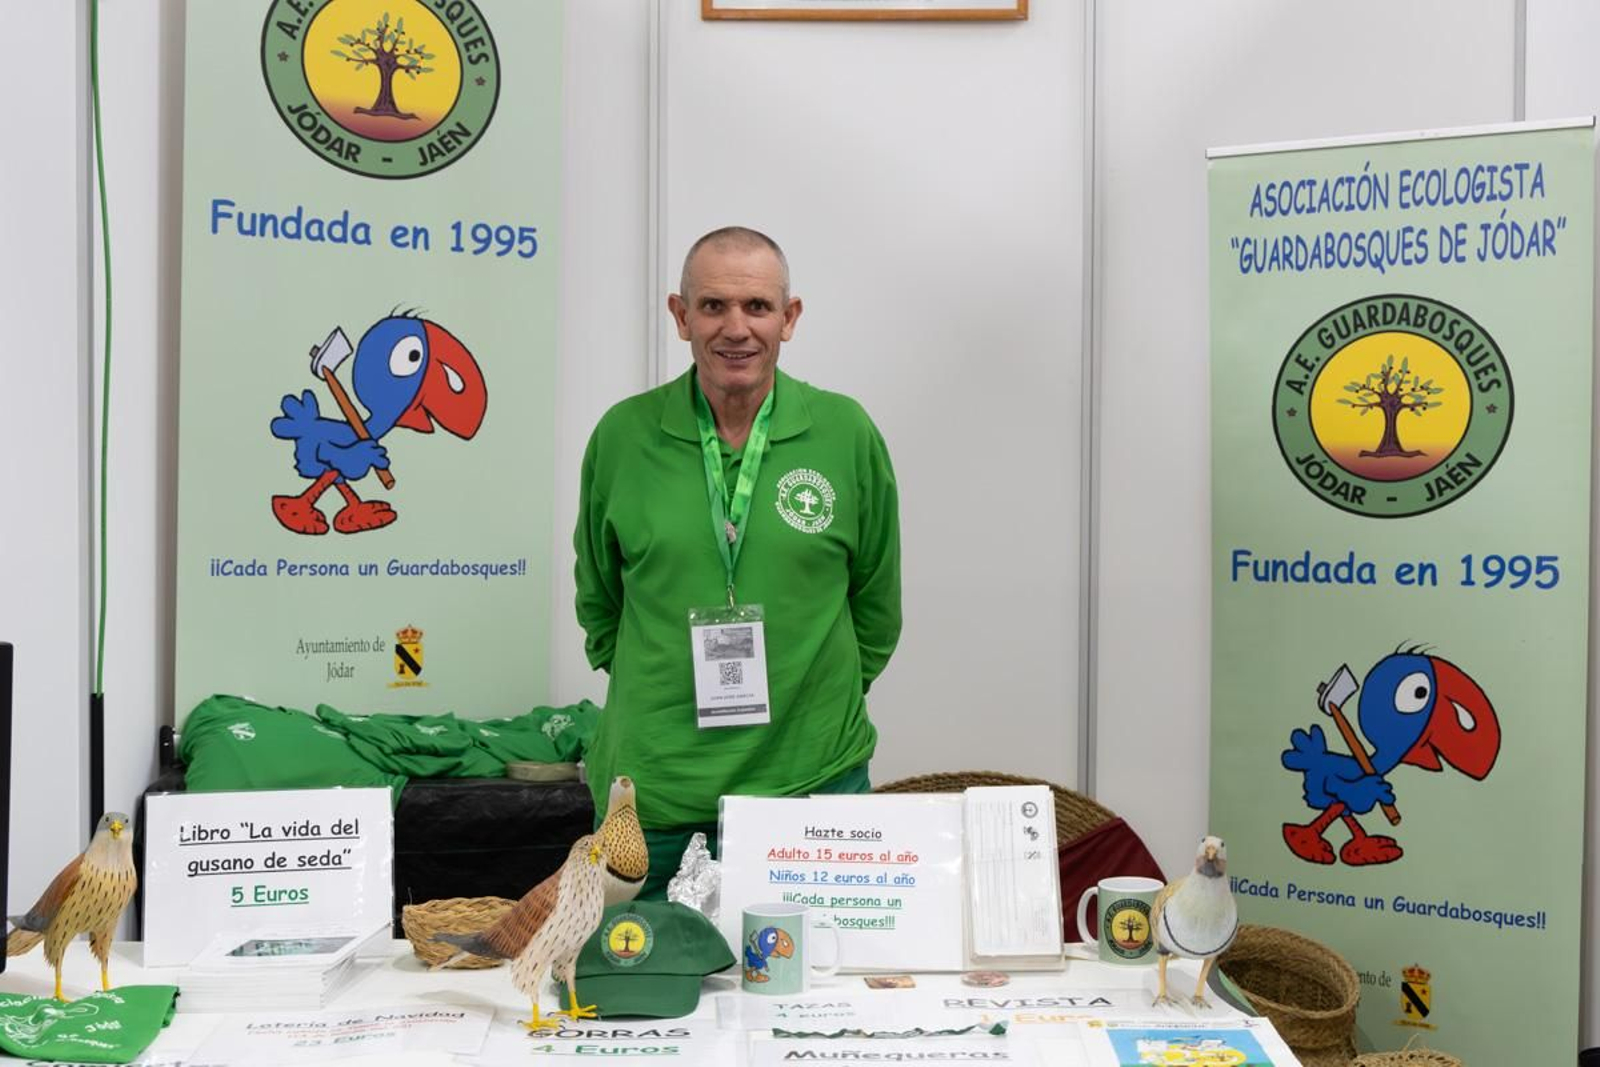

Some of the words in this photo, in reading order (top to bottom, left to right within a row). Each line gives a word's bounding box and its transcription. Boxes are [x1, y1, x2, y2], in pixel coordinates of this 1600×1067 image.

[287, 102, 362, 164] JÓDAR
[418, 121, 473, 167] JAÉN
[1250, 161, 1390, 218] ASOCIACIÓN
[1399, 162, 1546, 210] ECOLOGISTA
[210, 199, 372, 246] Fundada
[390, 225, 430, 251] en
[450, 221, 538, 259] 1995
[1439, 222, 1468, 265] DE
[1285, 353, 1321, 396] A.E.
[1317, 301, 1502, 395] GUARDABOSQUES
[1295, 453, 1367, 506] JÓDAR
[1424, 452, 1484, 503] JAÉN
[276, 558, 350, 577] Persona
[358, 563, 379, 576] un
[386, 558, 527, 580] Guardabosques!!
[1231, 549, 1377, 585] Fundada
[1394, 559, 1438, 587] en
[1460, 553, 1560, 590] 1995
[296, 637, 371, 660] Ayuntamiento
[372, 635, 386, 652] de
[326, 661, 355, 682] Jódar
[179, 822, 231, 843] Libro
[282, 820, 321, 838] vida
[330, 818, 360, 837] del
[804, 826, 844, 838] Hazte
[850, 828, 882, 840] socio
[187, 855, 255, 877] gusano
[264, 851, 287, 869] de
[767, 848, 810, 861] Adulto
[817, 849, 833, 861] 15
[838, 853, 874, 862] euros
[880, 850, 891, 862] al
[897, 851, 919, 864] año
[769, 870, 806, 883] Niños
[814, 871, 829, 882] 12
[834, 873, 870, 885] euros
[876, 872, 888, 885] al
[894, 873, 916, 886] año
[231, 886, 245, 904] 5
[254, 884, 310, 903] Euros
[830, 896, 882, 909] persona
[887, 897, 903, 908] un
[1287, 883, 1356, 908] Persona
[1364, 895, 1385, 911] un
[1392, 895, 1547, 930] Guardabosques!!
[1378, 970, 1392, 988] de
[943, 997, 1112, 1008] REVISTA
[527, 1028, 691, 1038] GORRAS
[534, 1044, 555, 1053] 4
[575, 1044, 680, 1055] Euros
[784, 1050, 1009, 1062] Muñequeras
